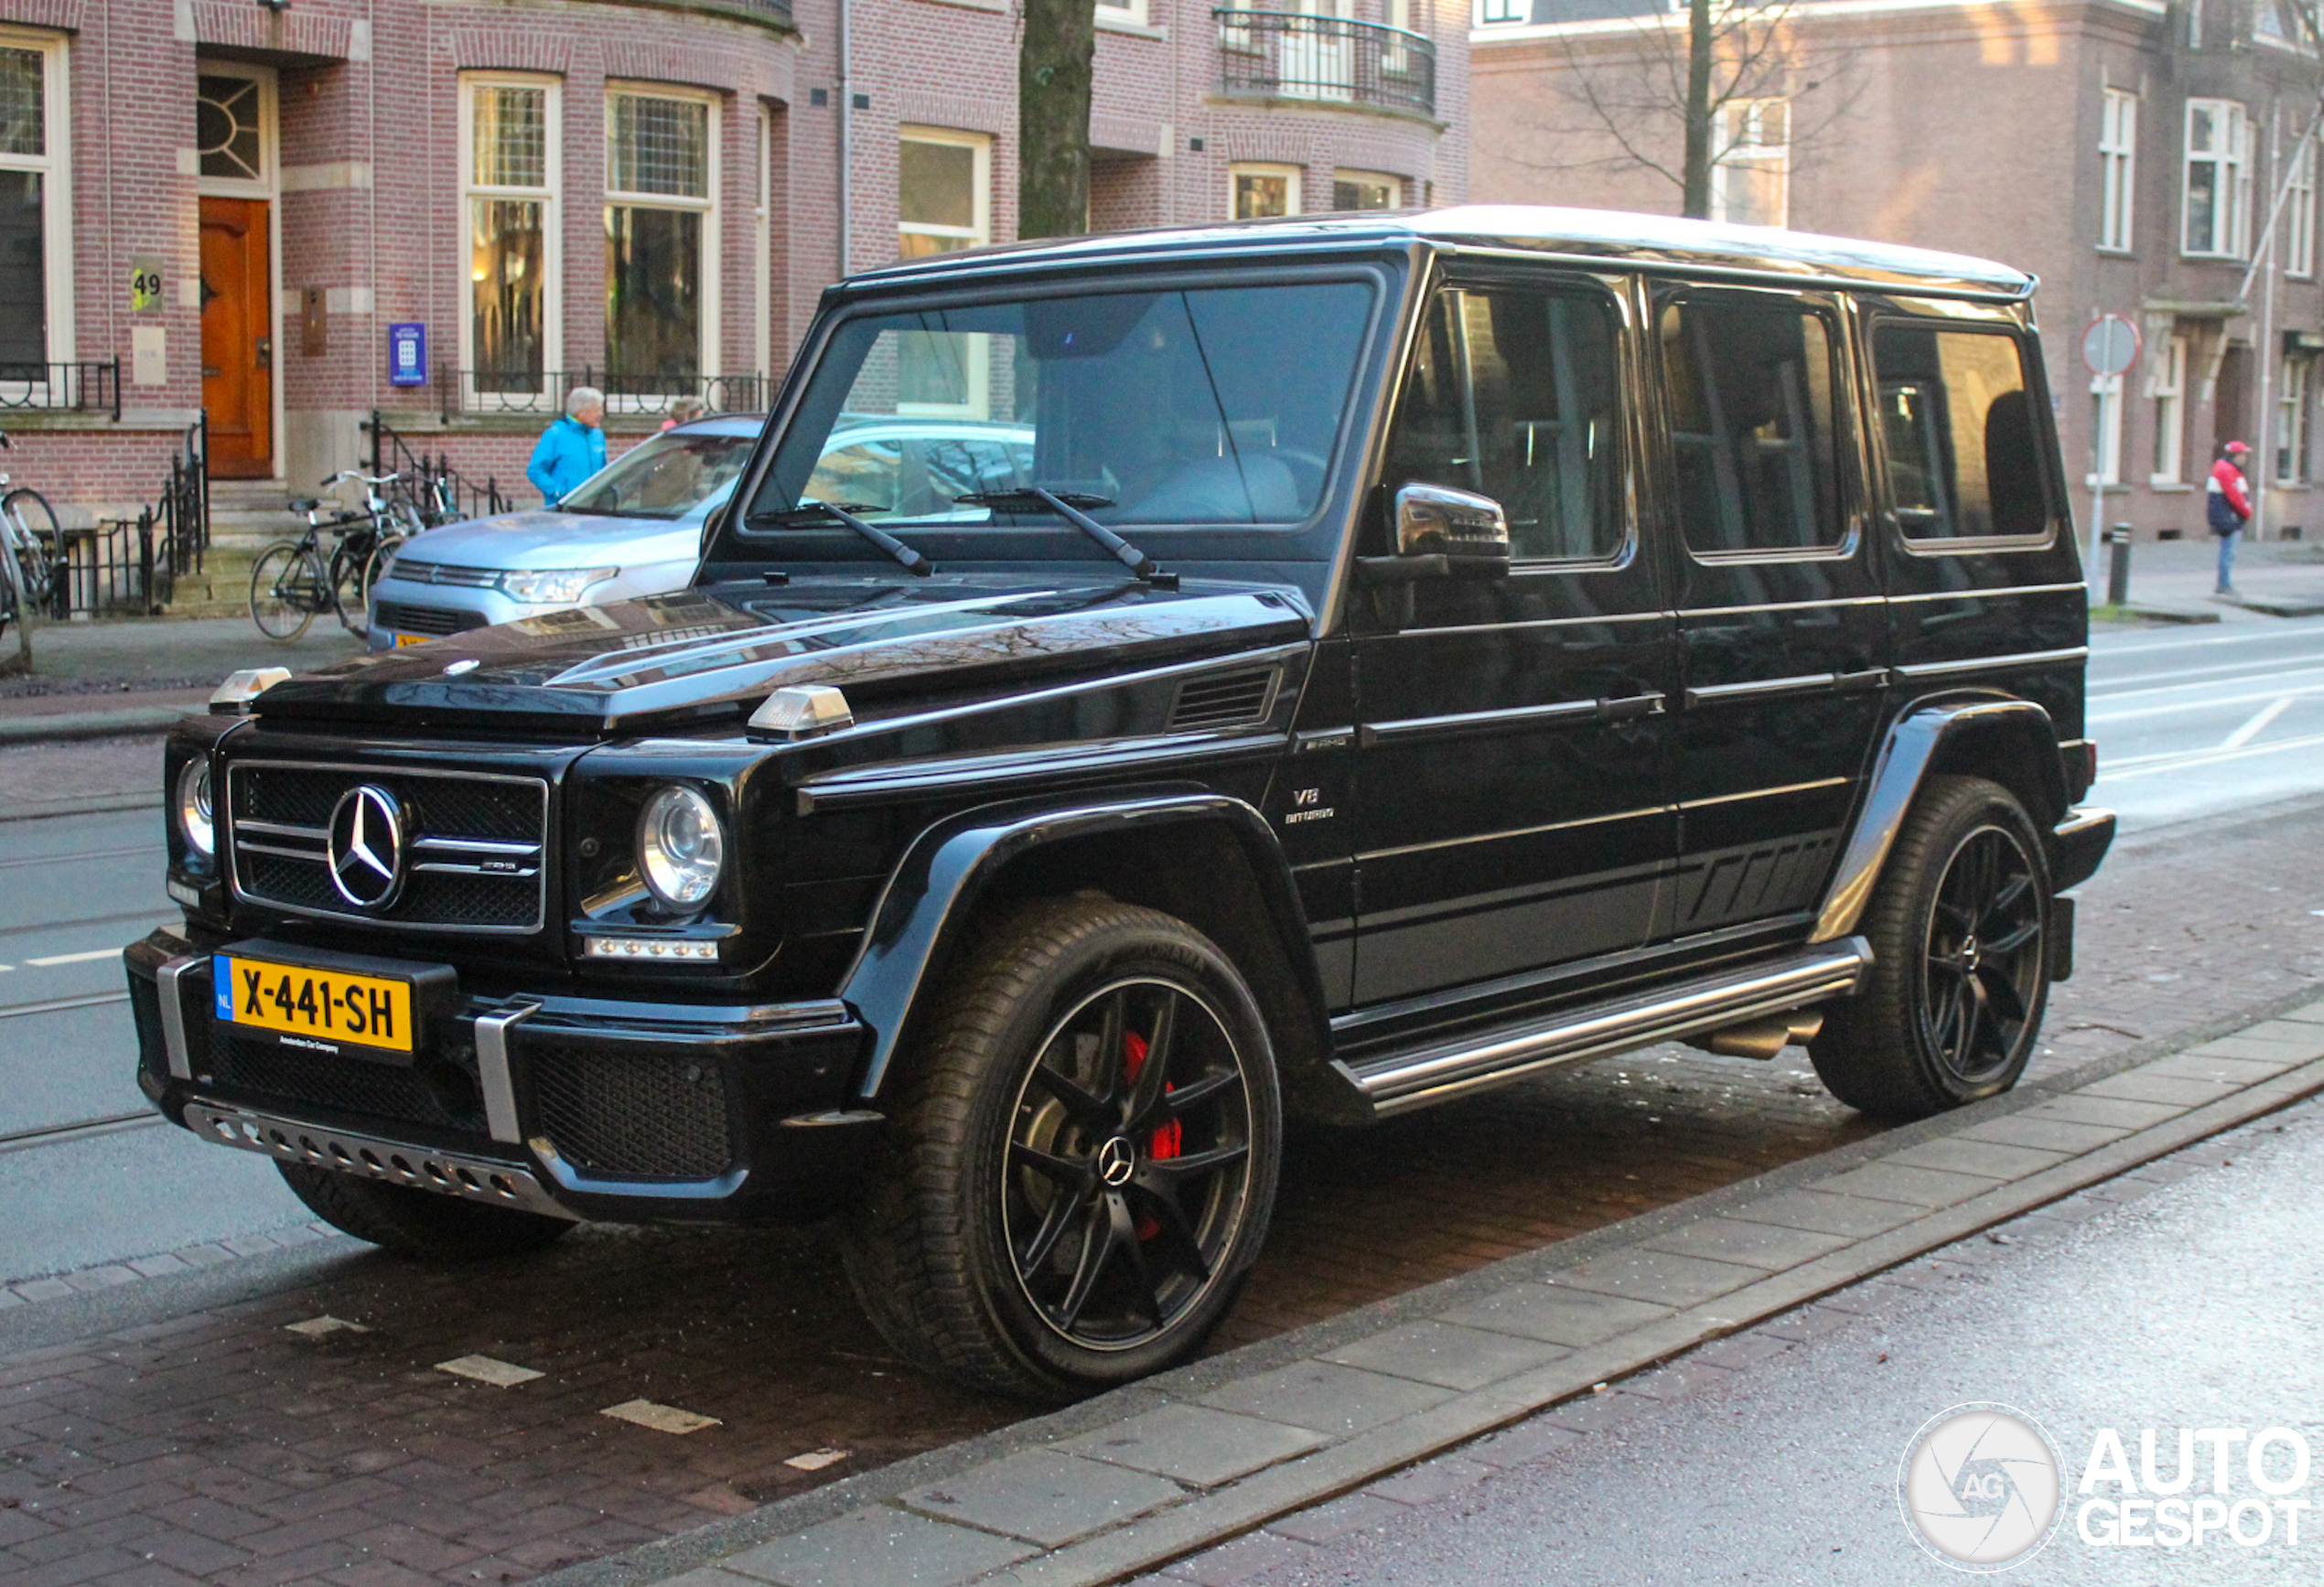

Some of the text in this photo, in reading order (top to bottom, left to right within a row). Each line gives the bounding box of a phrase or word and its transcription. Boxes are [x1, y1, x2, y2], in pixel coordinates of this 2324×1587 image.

[134, 273, 161, 295] 49
[1294, 788, 1318, 806] V8
[218, 994, 231, 1009] NL
[243, 970, 393, 1038] X-441-SH
